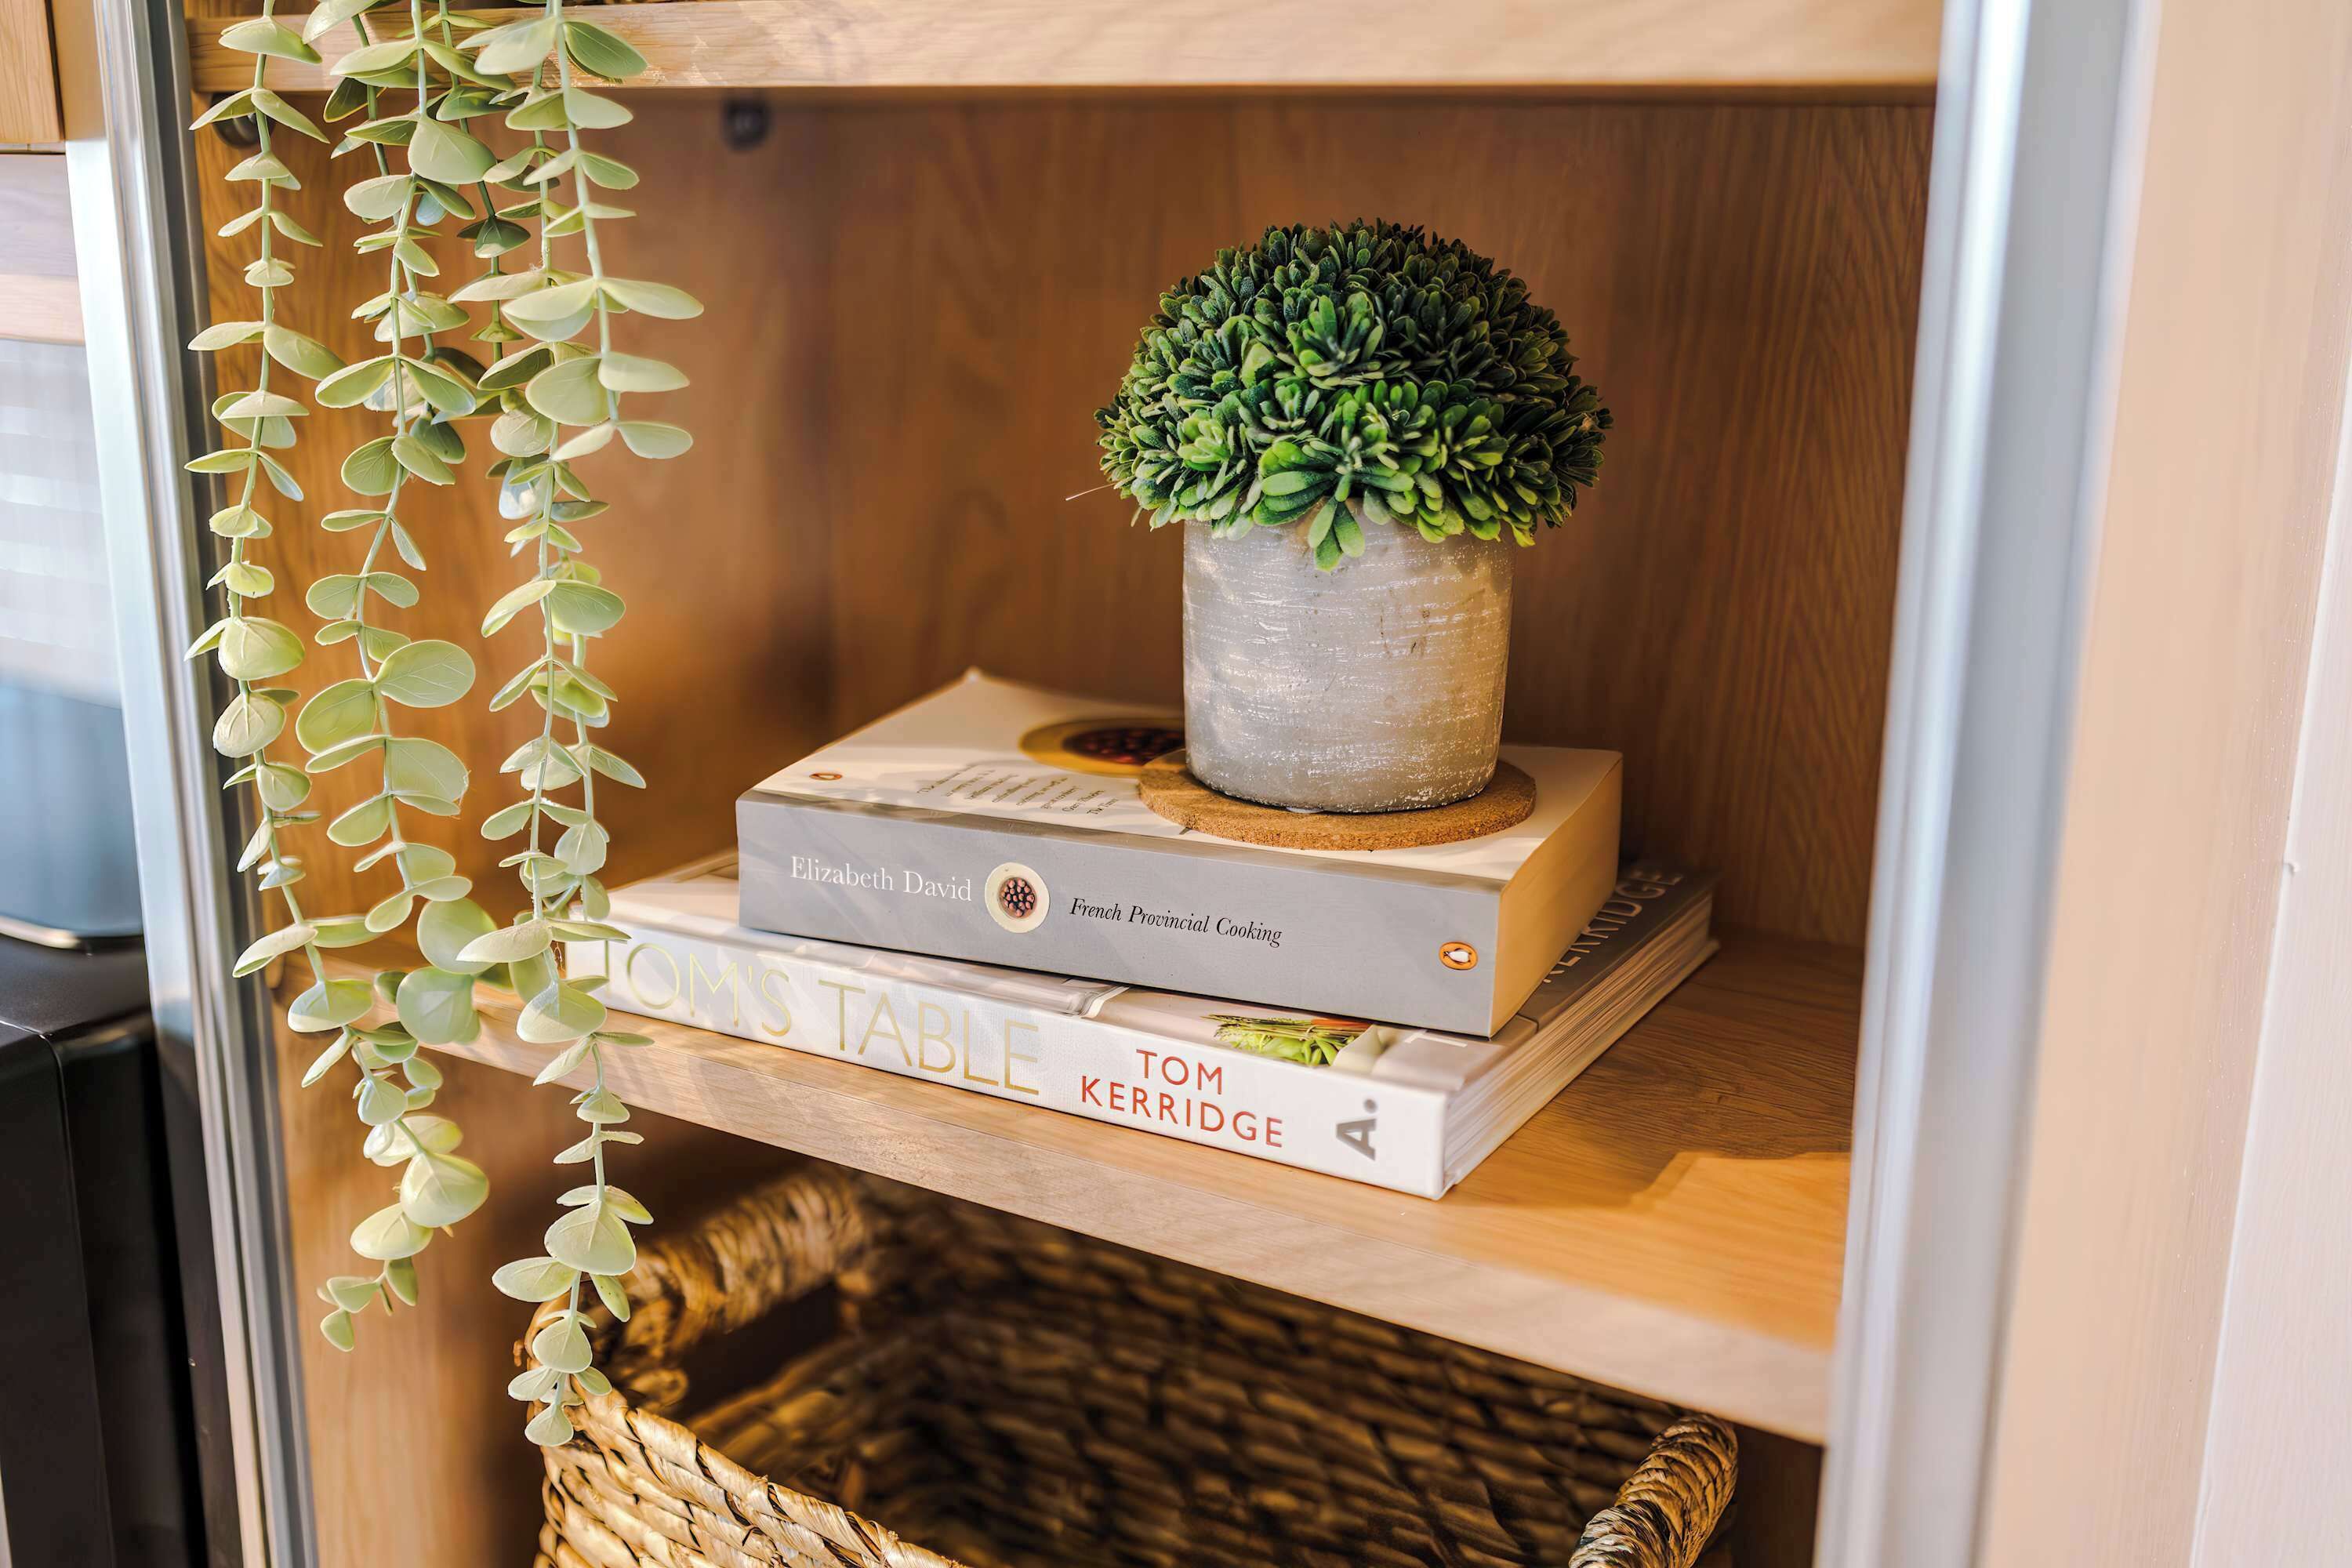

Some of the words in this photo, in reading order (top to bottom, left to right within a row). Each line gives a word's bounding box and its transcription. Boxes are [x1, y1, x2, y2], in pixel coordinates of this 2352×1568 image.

[790, 855, 895, 891] Elizabeth
[903, 870, 972, 902] David
[1069, 897, 1122, 921] French
[1128, 905, 1210, 933] Provincial
[1216, 916, 1283, 949] Cooking
[818, 978, 1040, 1096] TABLE
[1135, 1048, 1223, 1095] TOM
[1081, 1074, 1283, 1148] KERRIDGE
